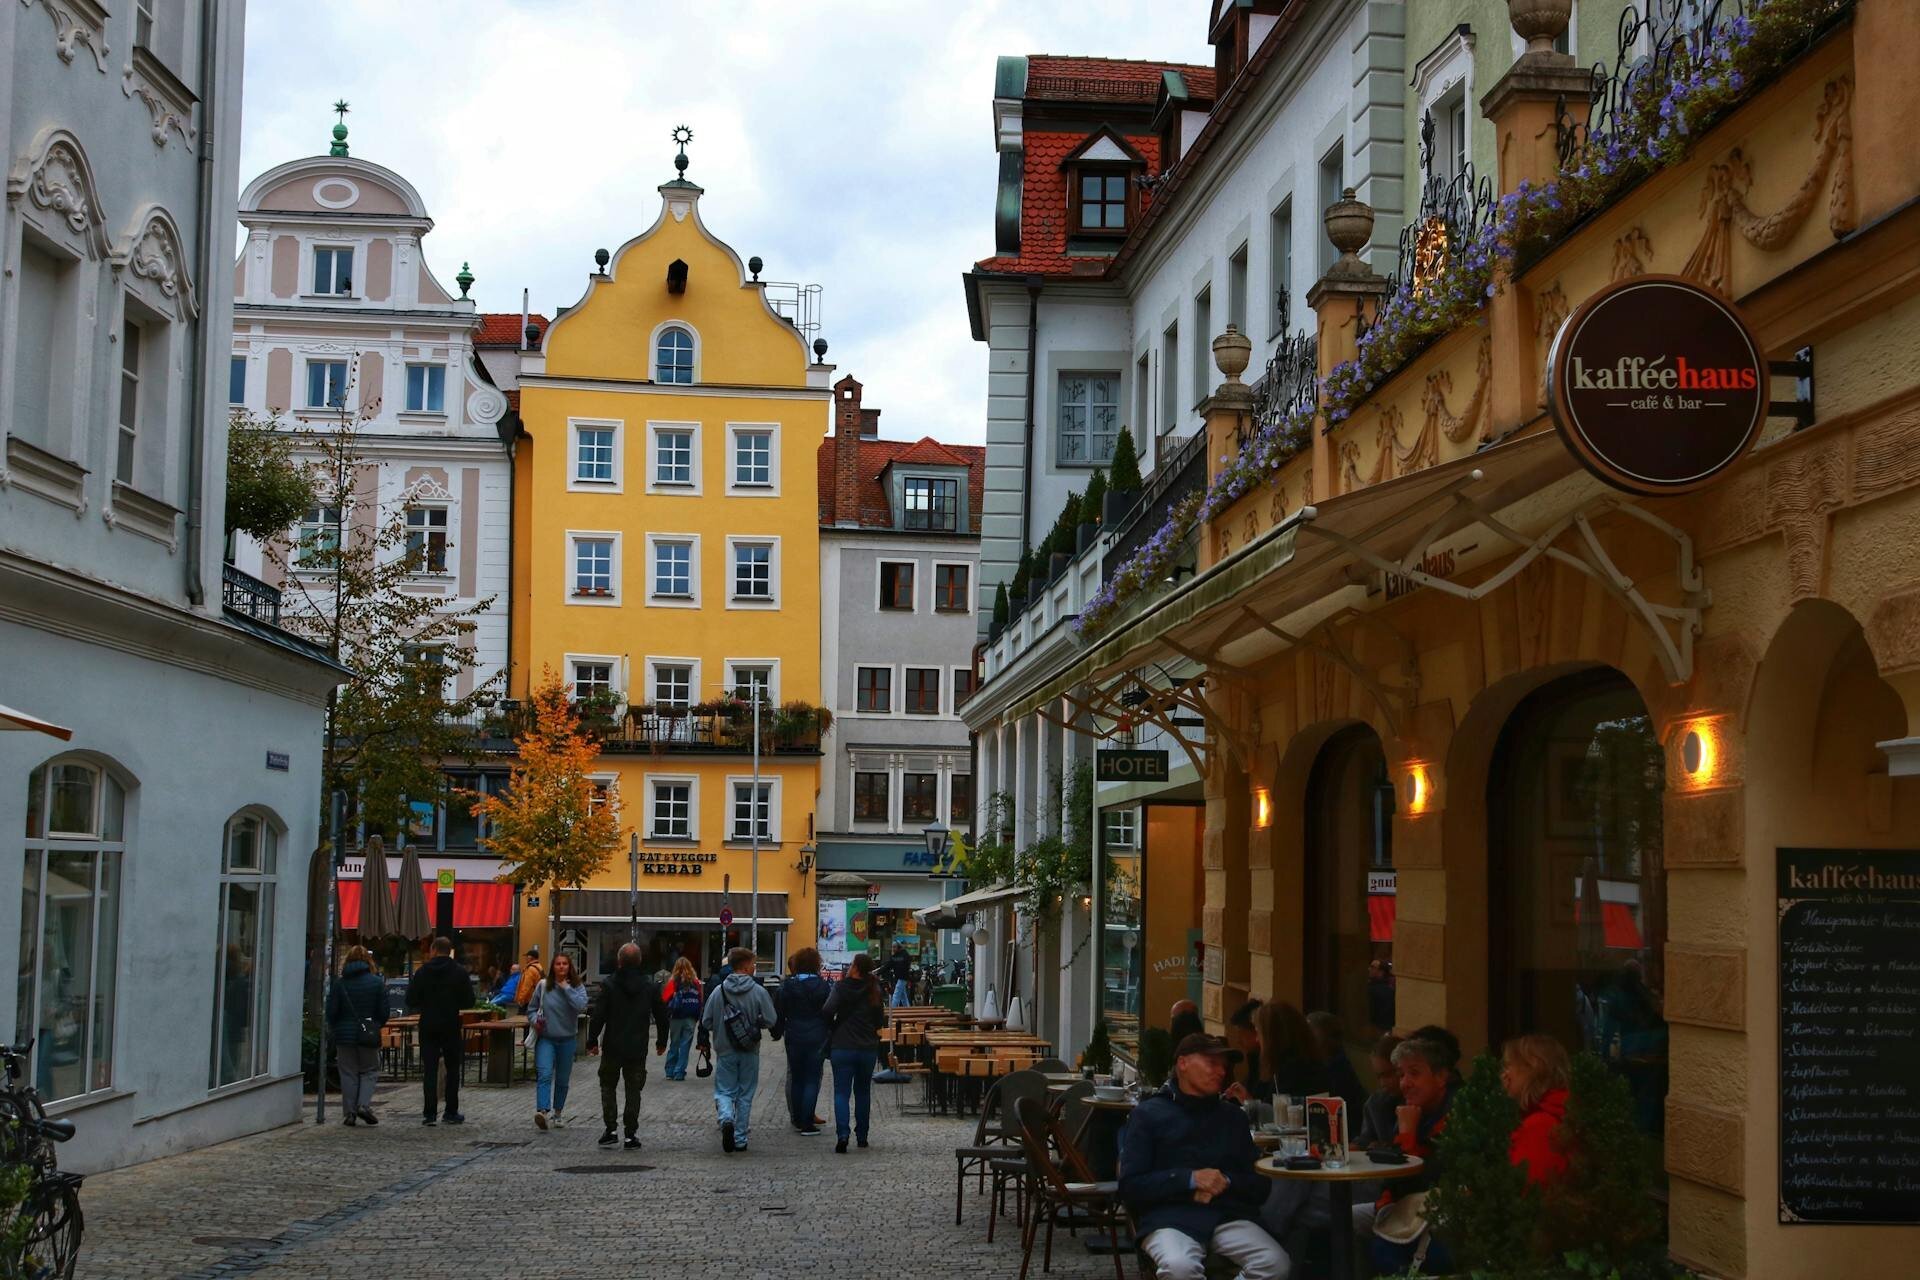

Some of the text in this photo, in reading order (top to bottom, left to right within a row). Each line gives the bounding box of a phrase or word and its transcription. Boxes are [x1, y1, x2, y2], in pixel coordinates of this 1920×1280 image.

[1572, 354, 1757, 390] kafféehaus
[1631, 395, 1702, 409] café & bar
[1101, 757, 1165, 775] HOTEL
[672, 853, 717, 862] VEGGIE
[643, 863, 702, 874] KEBAB
